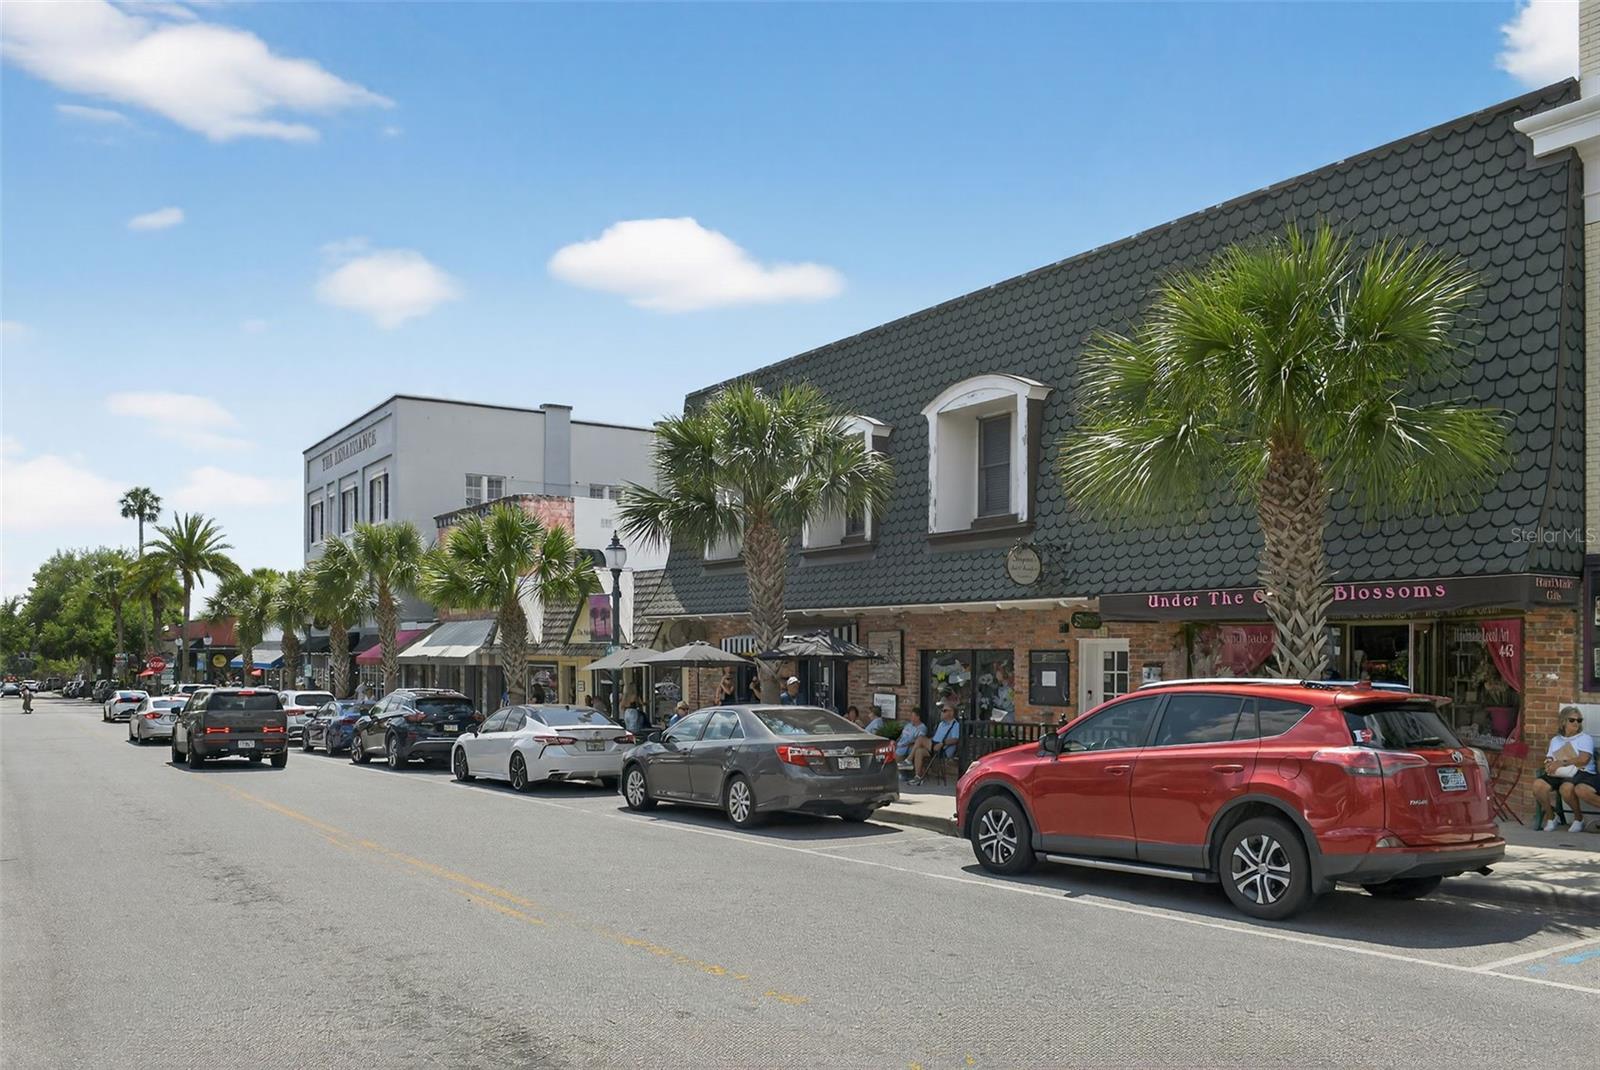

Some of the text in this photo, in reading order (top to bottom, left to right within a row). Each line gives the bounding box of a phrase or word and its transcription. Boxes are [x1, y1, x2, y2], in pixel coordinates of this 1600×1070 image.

[1148, 594, 1199, 608] Under
[1208, 591, 1244, 606] The
[1334, 584, 1446, 601] Blossoms
[1499, 644, 1514, 658] 443
